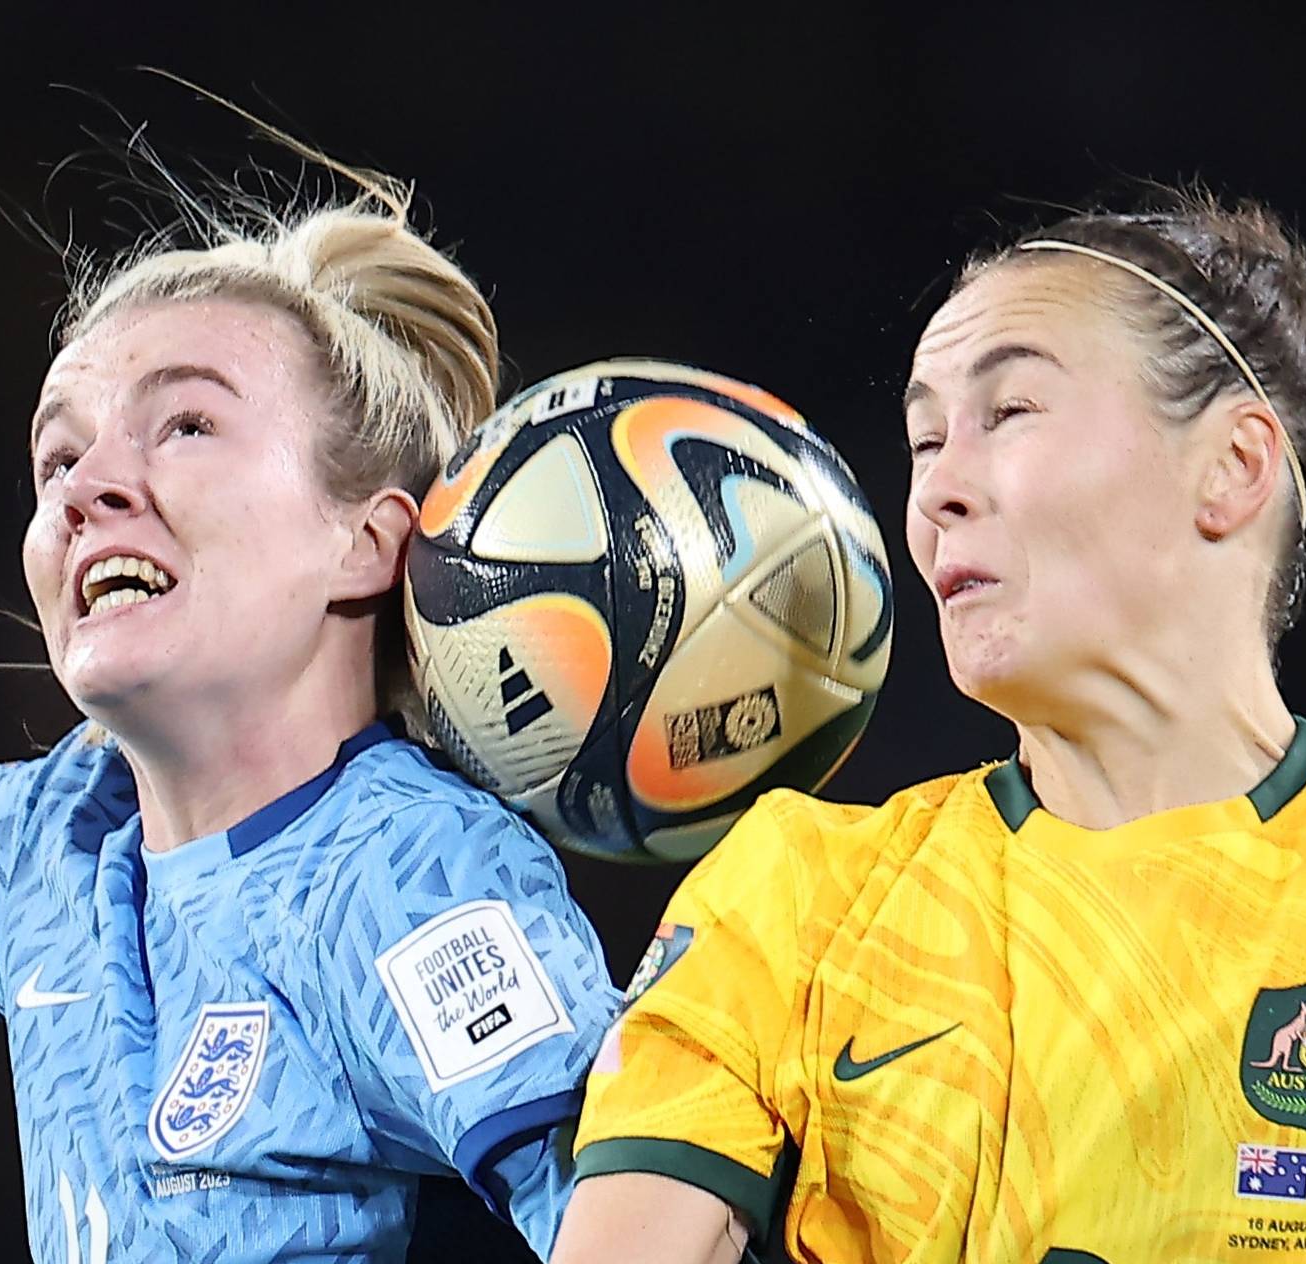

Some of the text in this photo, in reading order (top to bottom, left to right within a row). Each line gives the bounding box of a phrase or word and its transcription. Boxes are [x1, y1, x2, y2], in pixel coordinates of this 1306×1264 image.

[414, 926, 494, 981] FOOTBALL
[424, 945, 506, 1006] UNITES
[434, 967, 520, 1033] the World
[472, 1009, 508, 1040] FIFA
[155, 1171, 197, 1199] AUGUST
[1248, 1217, 1264, 1231] 16
[1227, 1233, 1291, 1251] SYDNEY,
